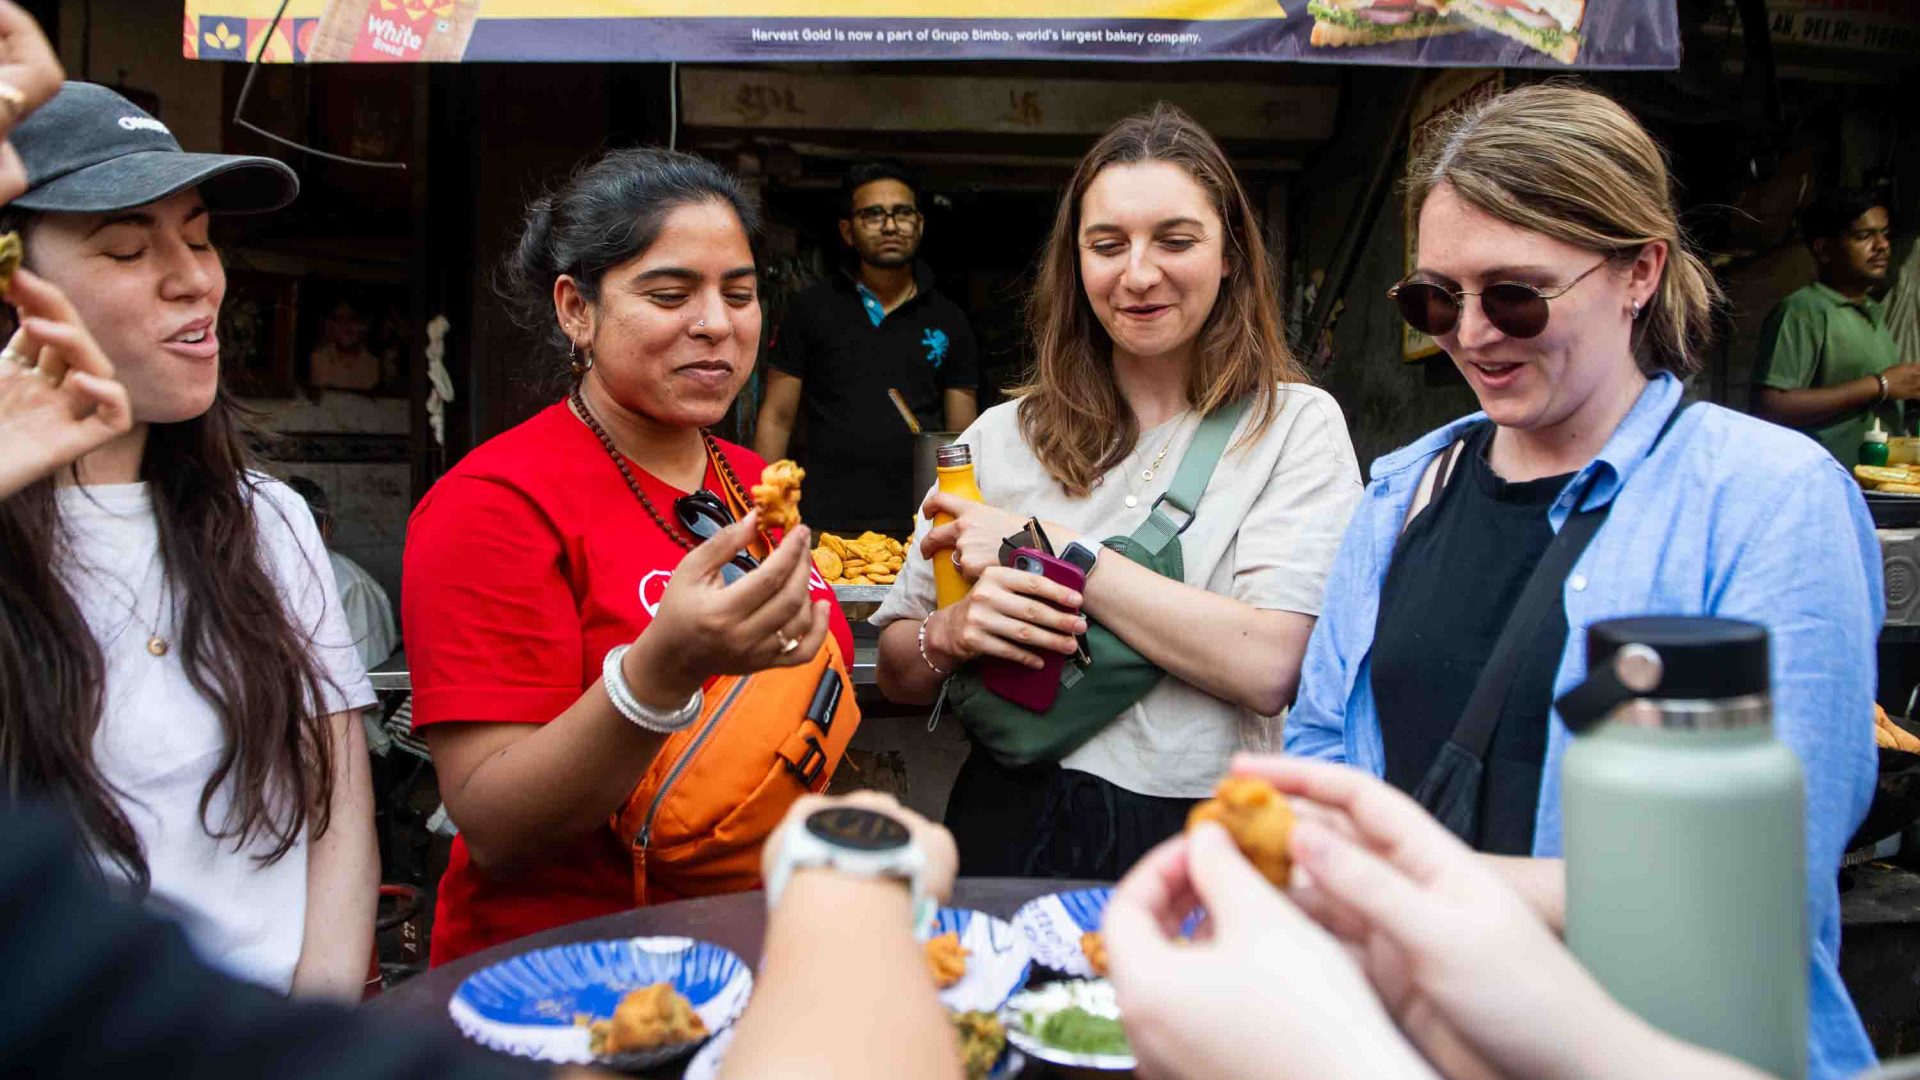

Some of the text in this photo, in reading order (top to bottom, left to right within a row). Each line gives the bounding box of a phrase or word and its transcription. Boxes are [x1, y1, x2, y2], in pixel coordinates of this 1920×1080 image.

[368, 13, 421, 50] White
[751, 28, 1202, 46] Harvest Gold is now a part of Grupo Bimbo, world's largest bakery company.
